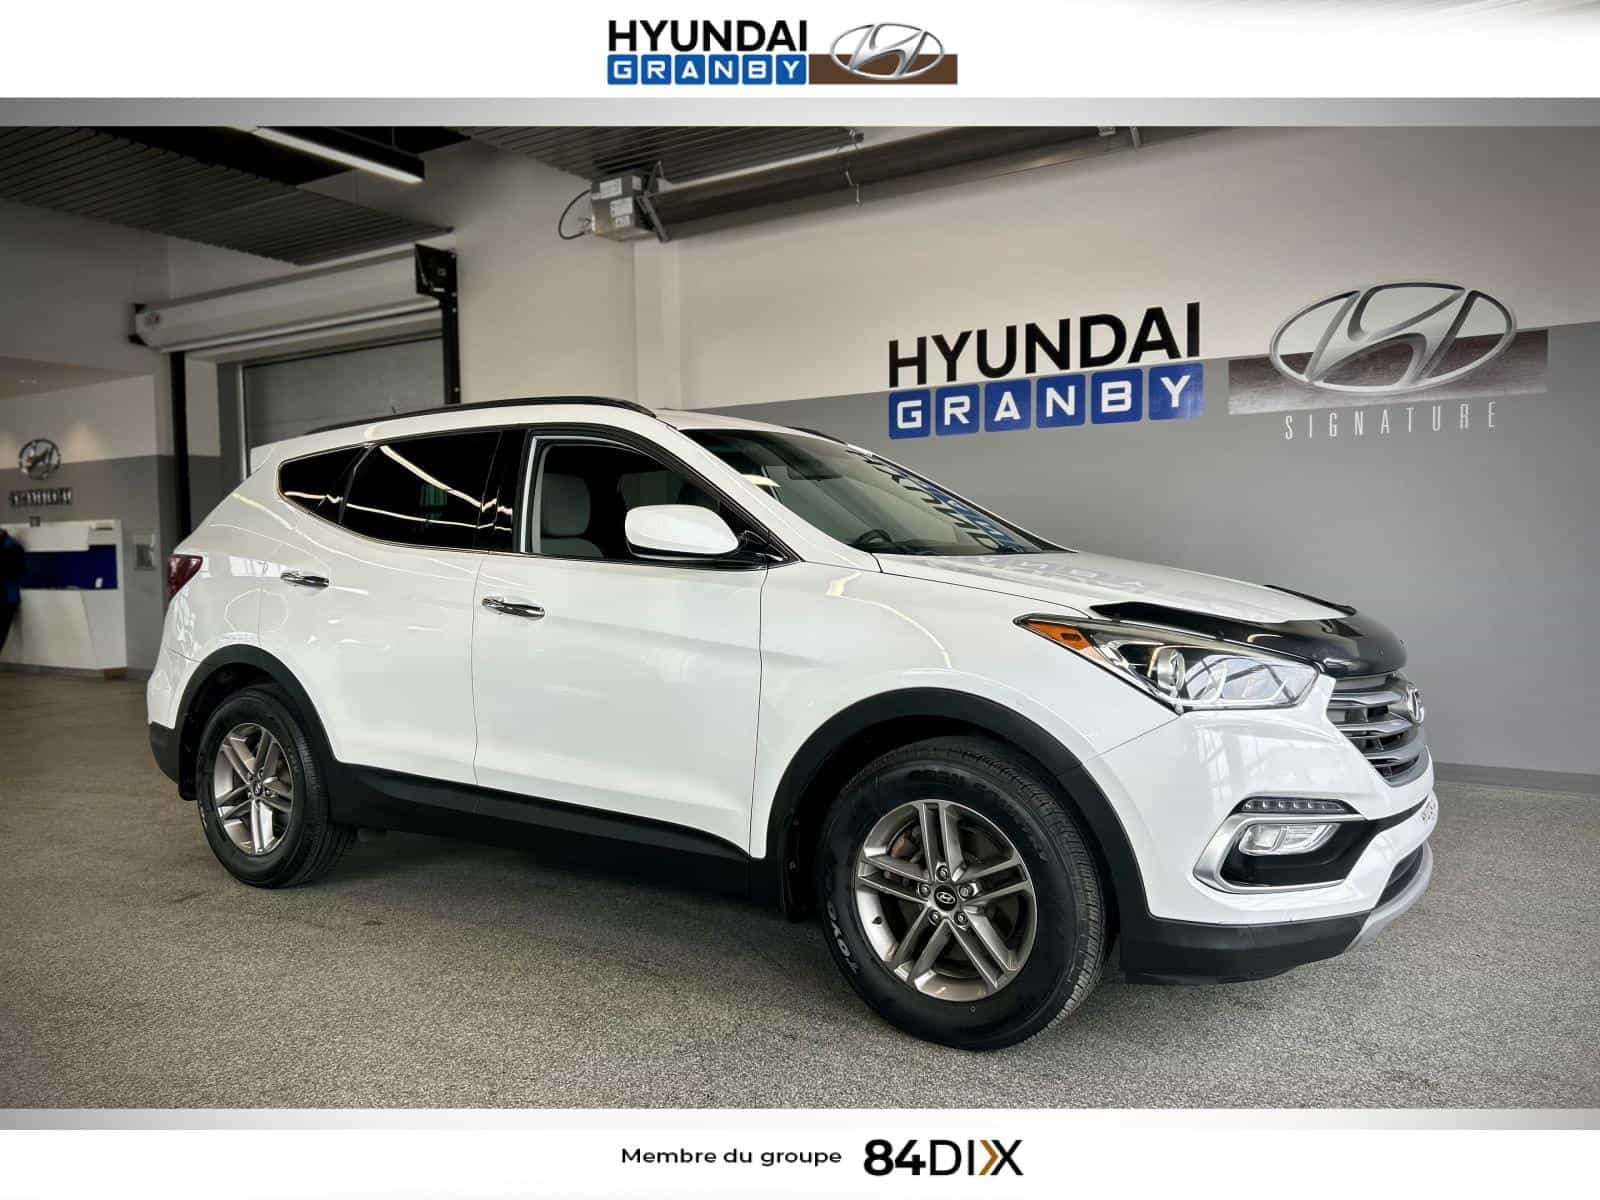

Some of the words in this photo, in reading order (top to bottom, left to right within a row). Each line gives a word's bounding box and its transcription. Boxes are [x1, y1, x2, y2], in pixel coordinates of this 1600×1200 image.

[889, 301, 1201, 388] HYUNDAI
[894, 372, 1194, 431] GRANBY
[1284, 401, 1497, 440] SIGNATURE
[826, 899, 859, 975] TOYO
